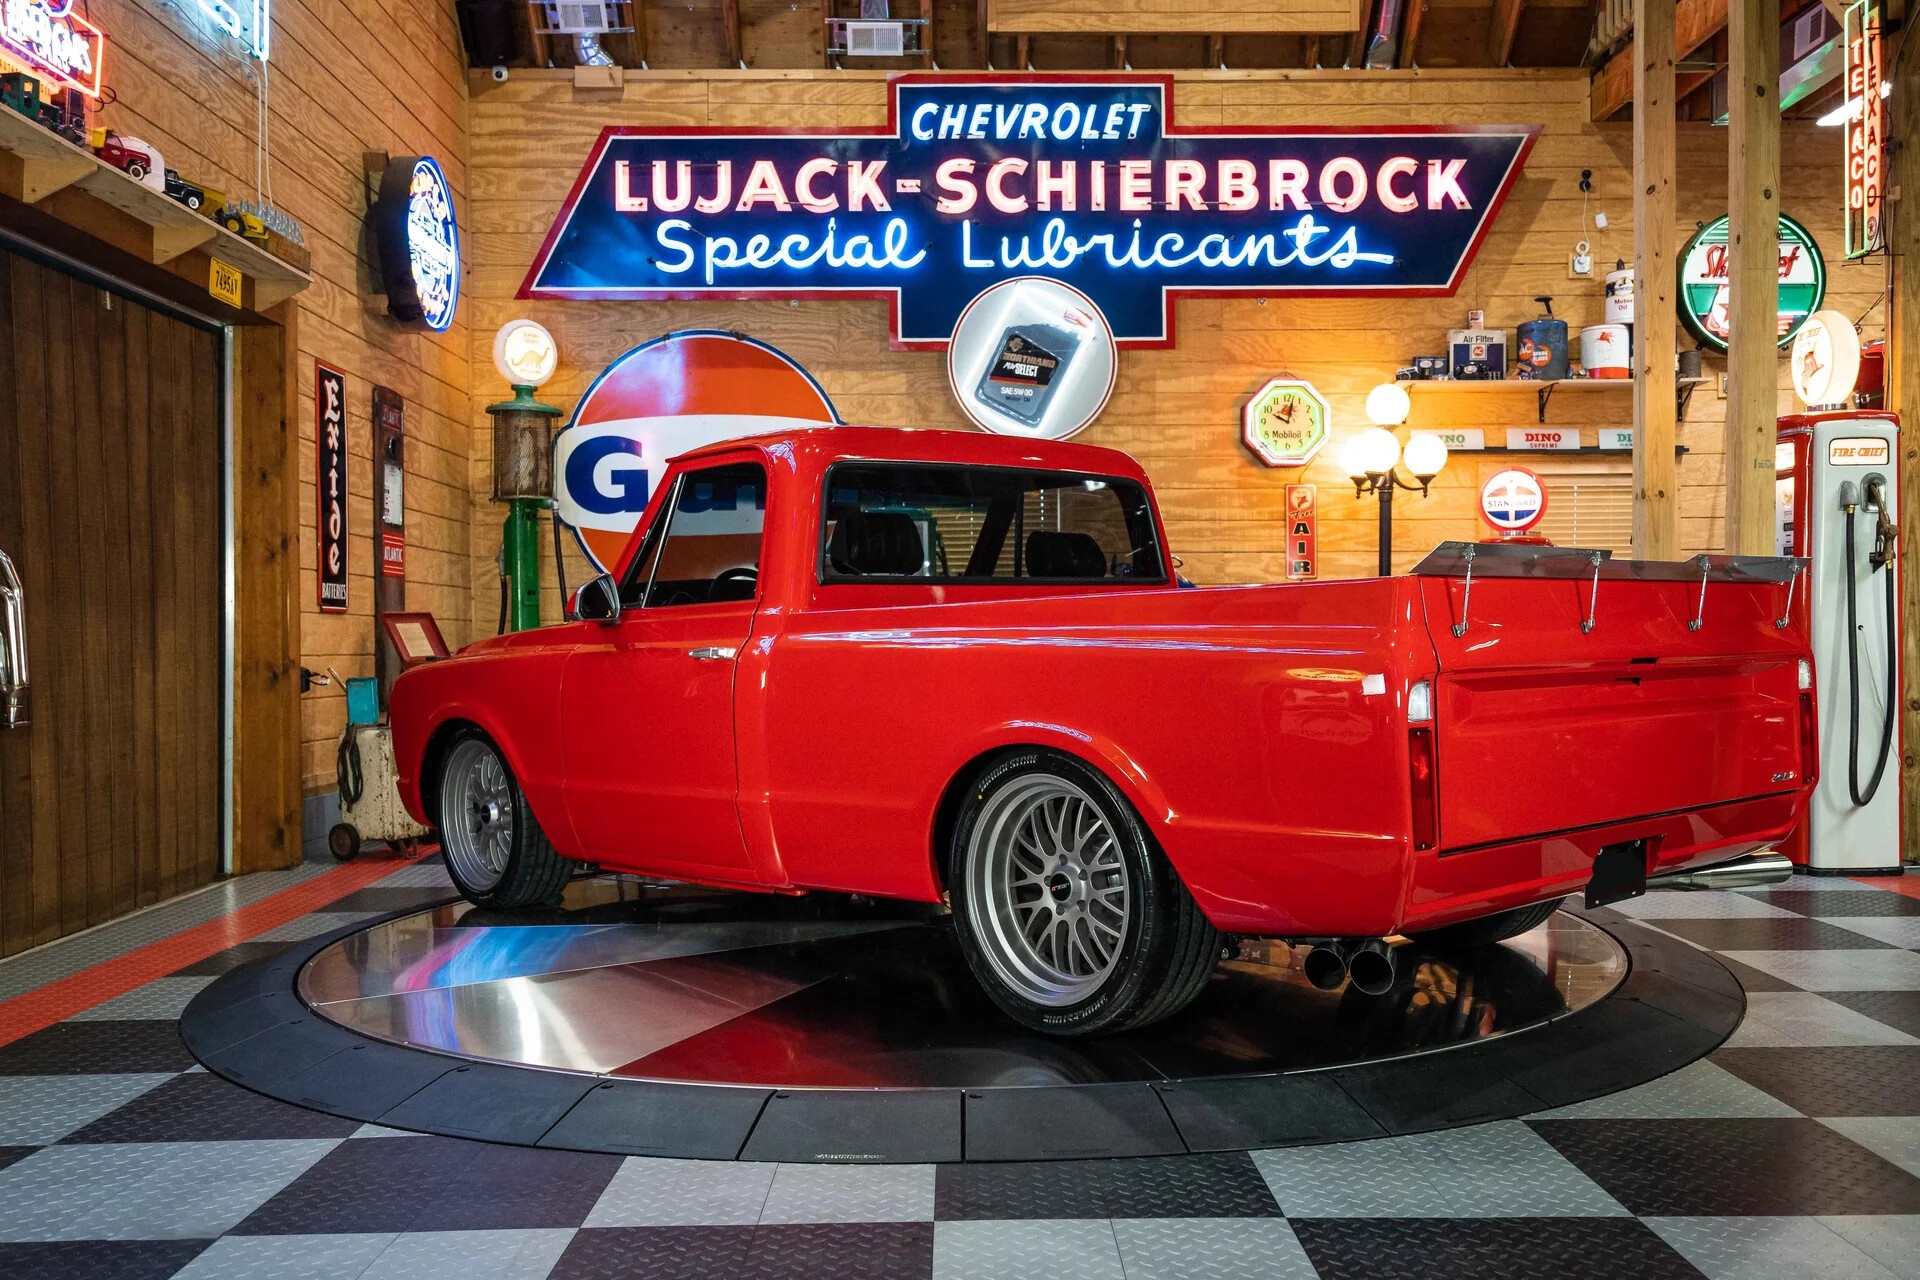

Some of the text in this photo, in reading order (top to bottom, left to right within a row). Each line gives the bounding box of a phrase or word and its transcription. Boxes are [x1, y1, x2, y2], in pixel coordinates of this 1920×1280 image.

[911, 101, 1151, 141] CHEVROLET
[614, 156, 1473, 214] LUJACK-SCHIERBROCK
[655, 213, 1395, 285] Special Lubricants
[1002, 352, 1055, 369] NORTHLAND
[1000, 386, 1014, 395] SAE
[1272, 430, 1301, 439] Mobiloil
[1524, 433, 1562, 443] DINO
[324, 378, 341, 575] Exide
[384, 546, 403, 562] ATLANTIC
[1291, 521, 1312, 574] AIR
[322, 582, 346, 599] BATTERIES
